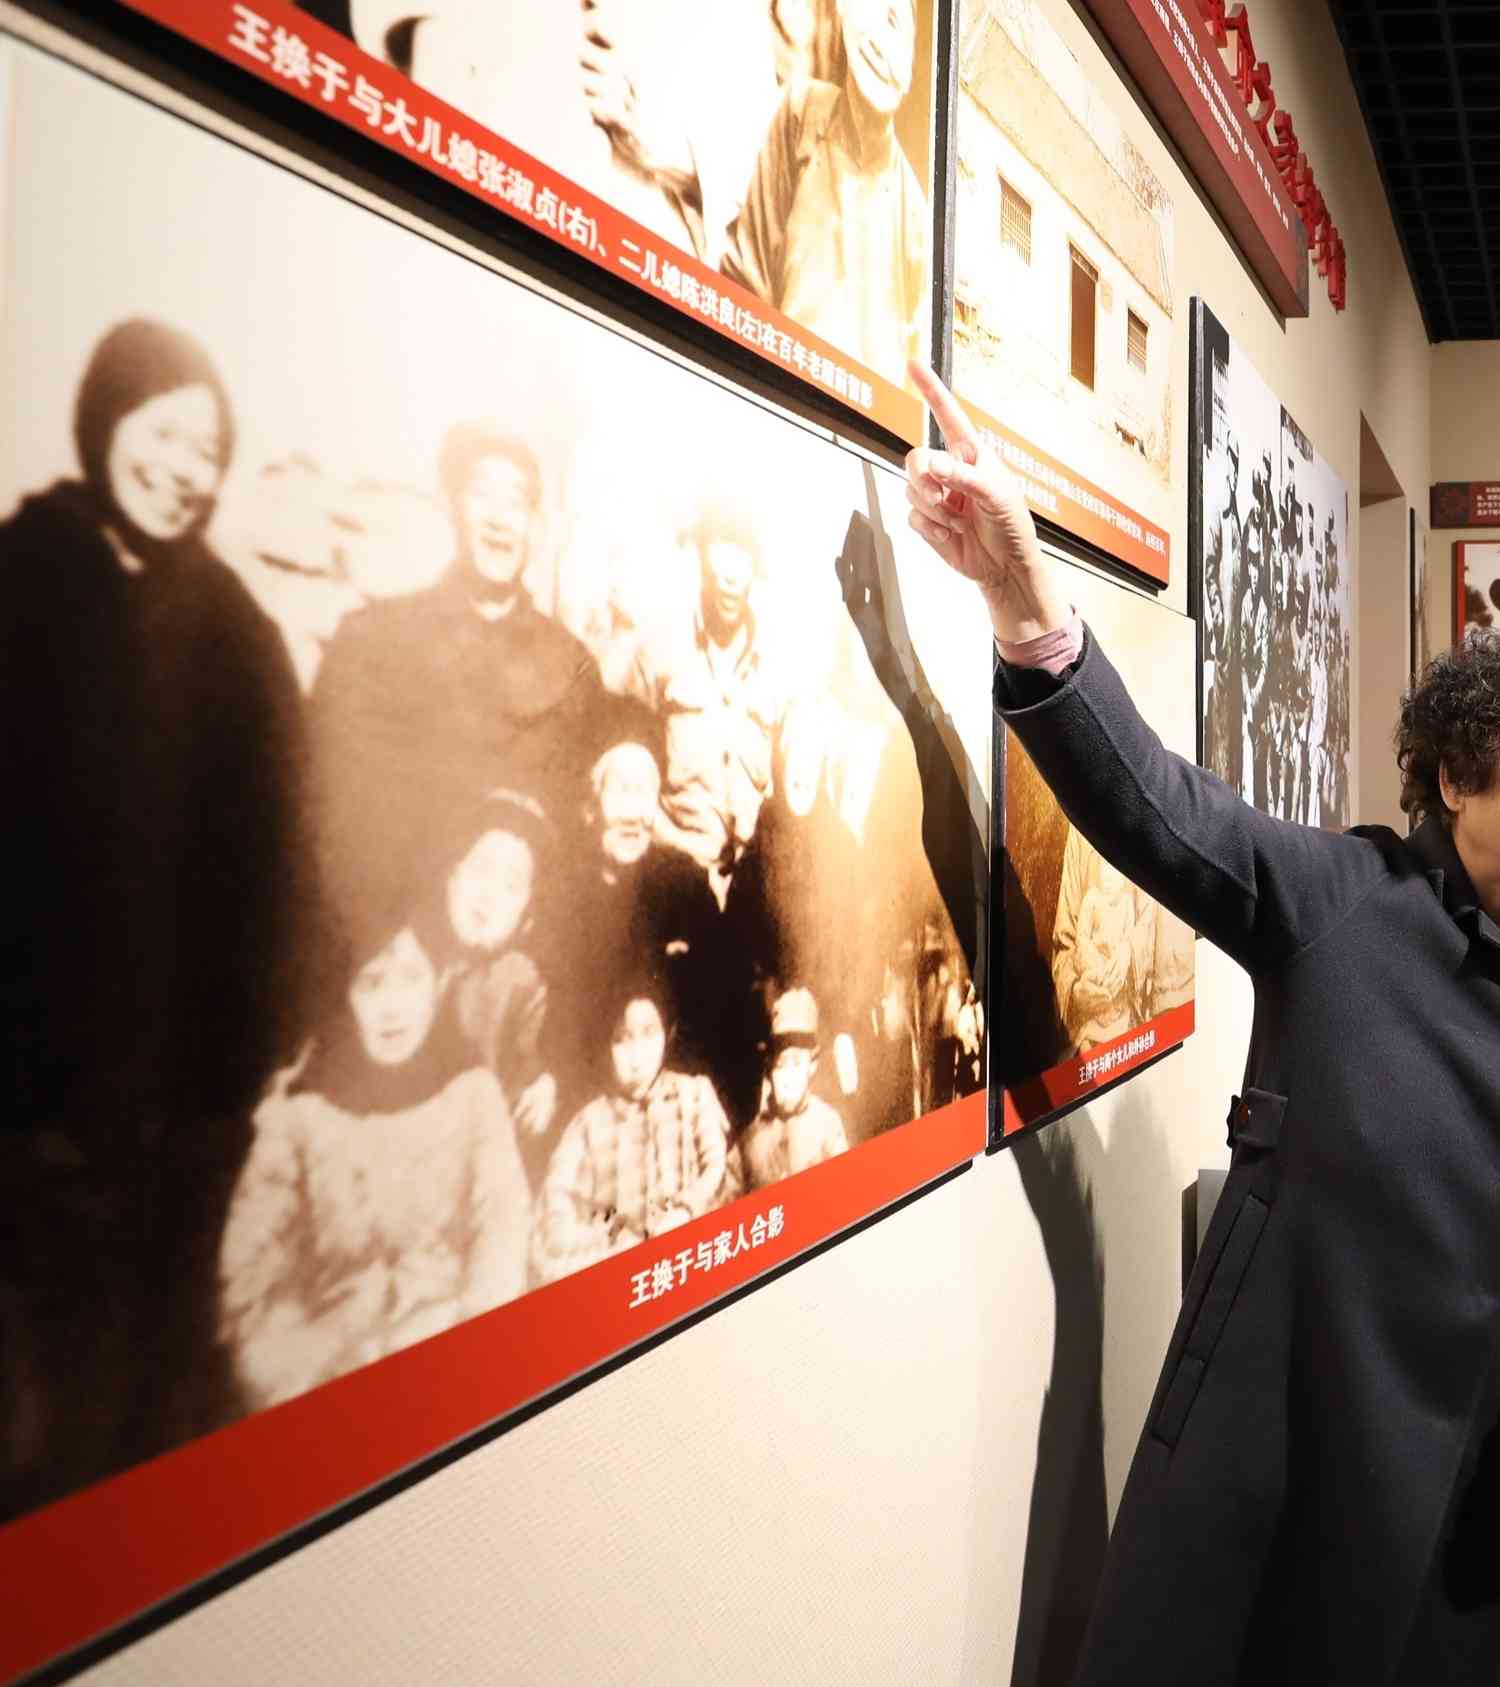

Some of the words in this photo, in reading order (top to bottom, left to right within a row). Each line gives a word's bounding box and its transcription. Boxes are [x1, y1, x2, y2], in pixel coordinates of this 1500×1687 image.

[628, 1205, 785, 1309] 王换于与家人合影
